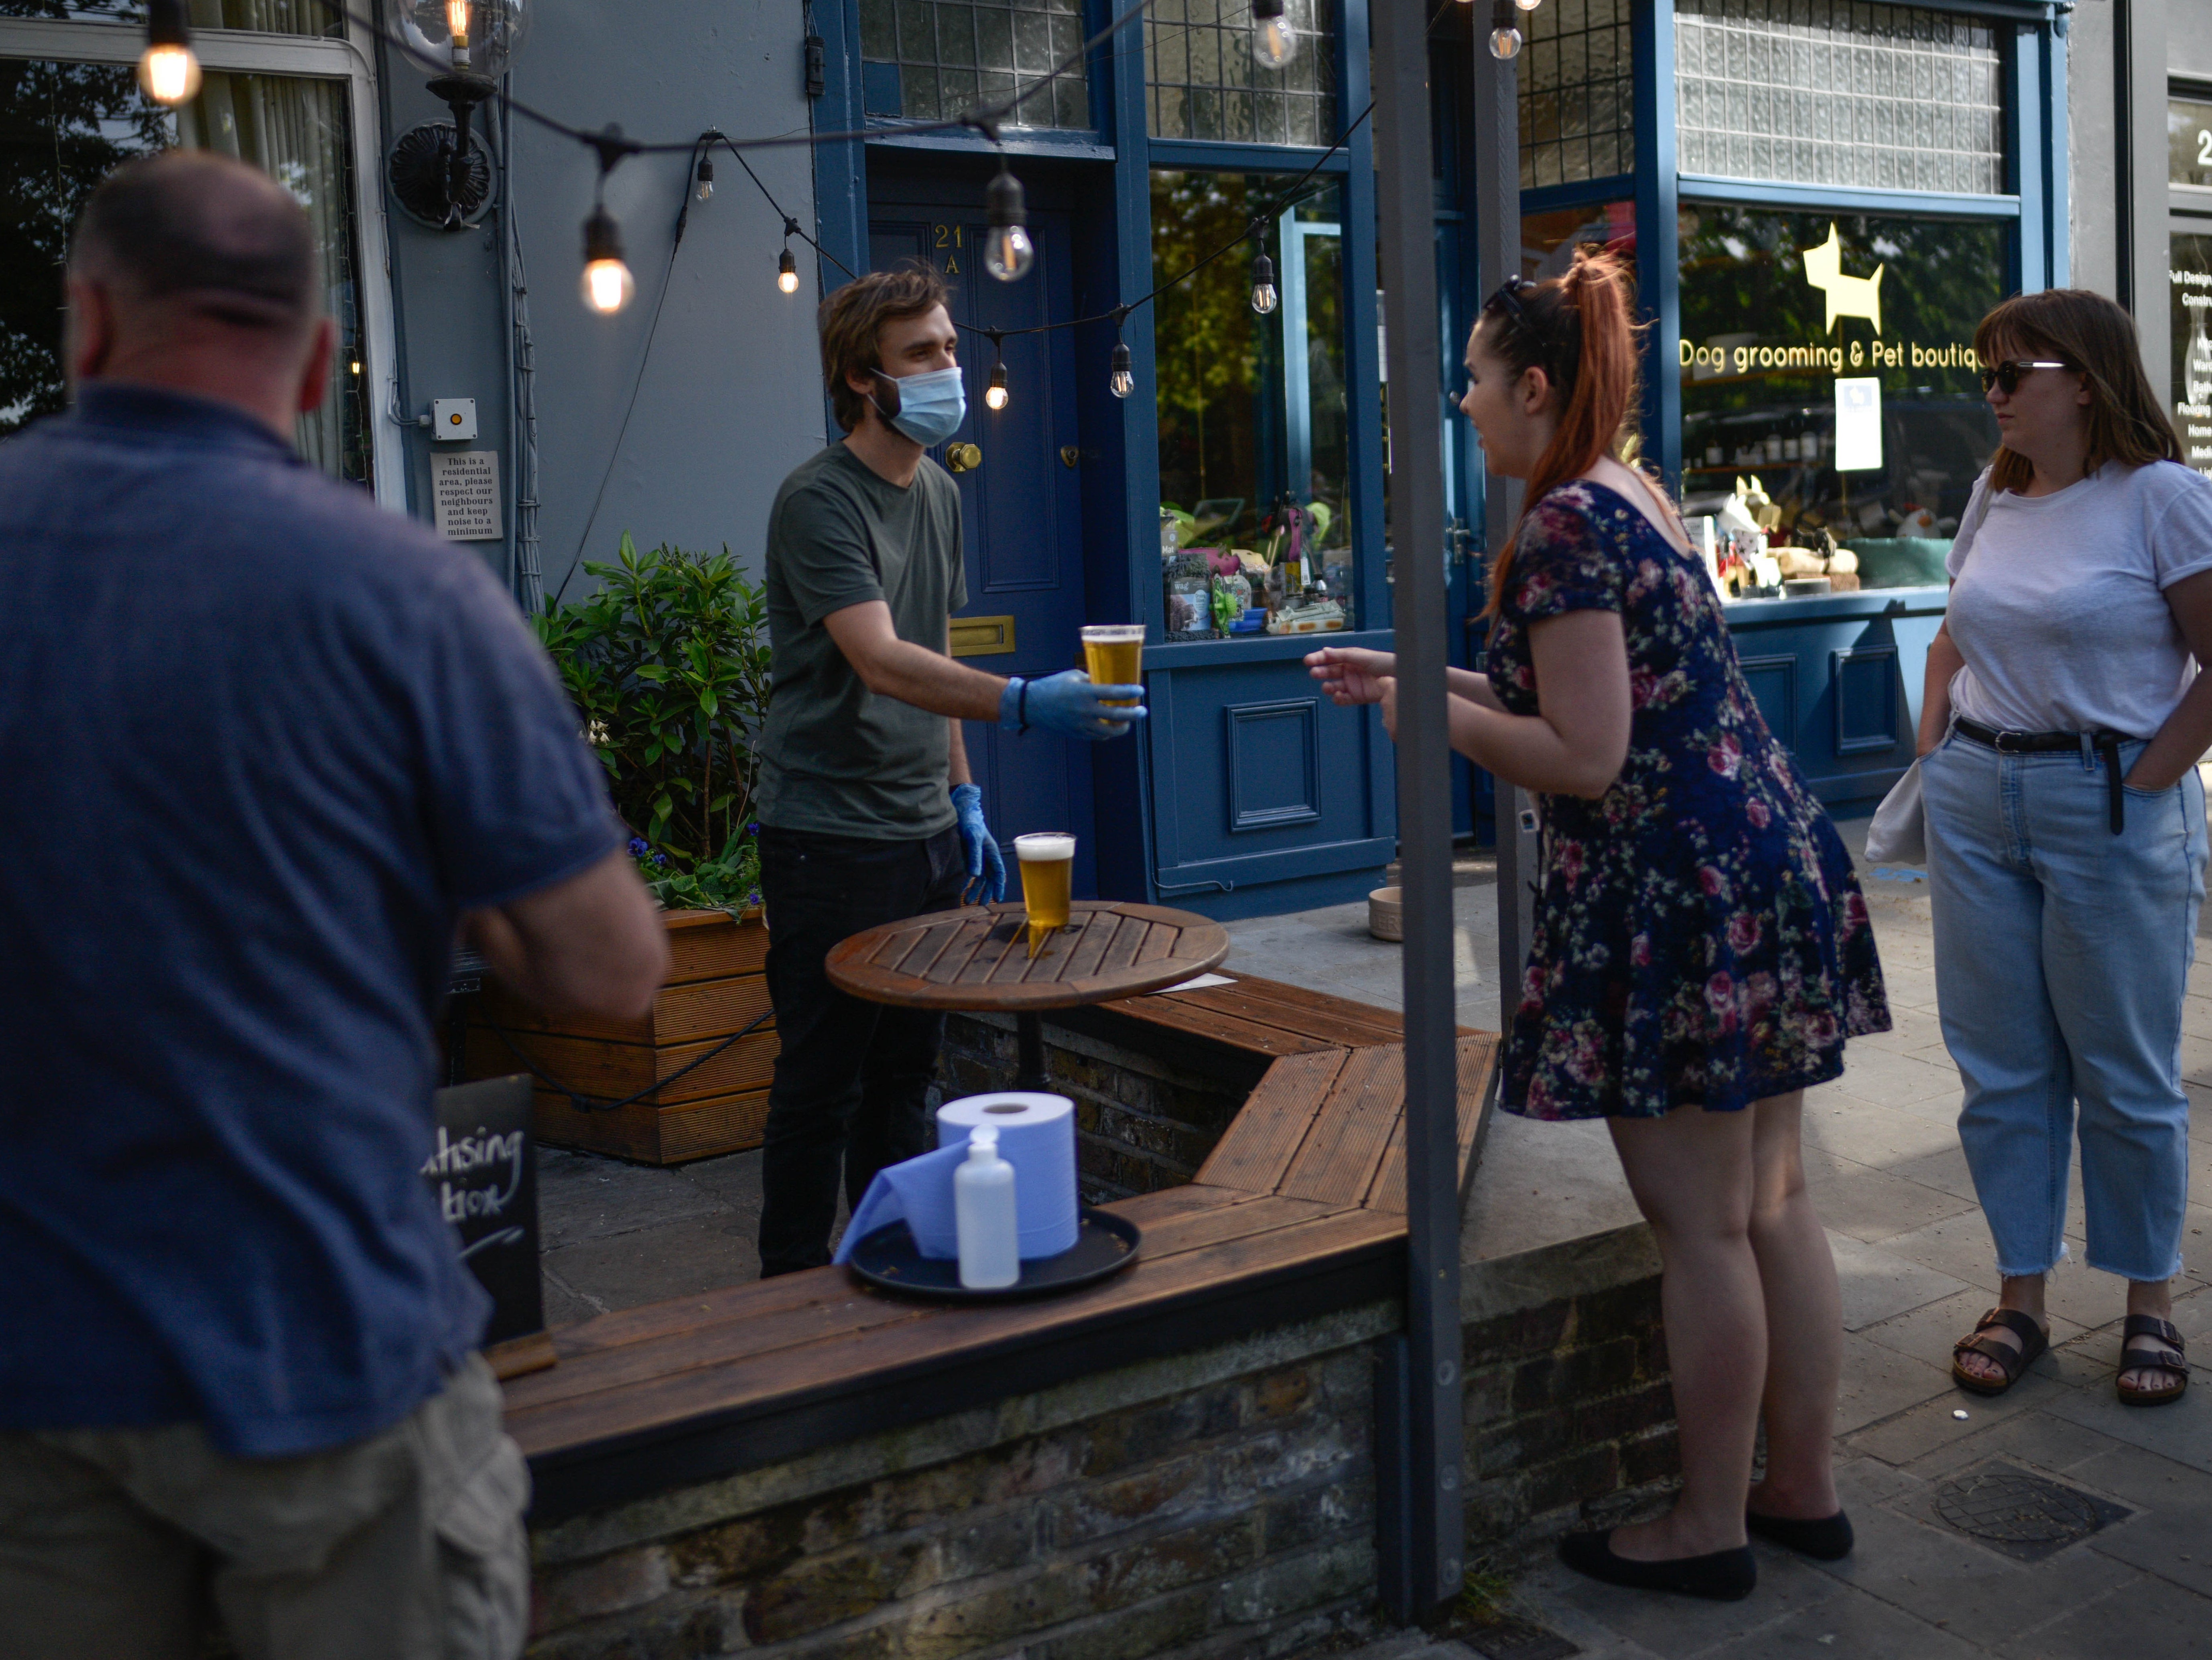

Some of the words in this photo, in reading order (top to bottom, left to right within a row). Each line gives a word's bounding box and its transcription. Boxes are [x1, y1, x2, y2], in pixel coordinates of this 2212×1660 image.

[2198, 129, 2212, 166] 2
[935, 224, 962, 248] 21
[945, 254, 960, 274] A
[1680, 339, 1725, 373] Dog
[1734, 342, 1842, 374] grooming
[1850, 341, 1865, 367] &
[1873, 341, 1903, 367] Pet
[2178, 402, 2210, 418] Flooring
[2188, 424, 2212, 437] Home
[2192, 445, 2212, 459] Medi
[443, 467, 491, 475] residential
[465, 477, 492, 486] please
[440, 488, 473, 497] respect
[441, 498, 493, 507] neighbours
[448, 508, 464, 516] and
[467, 507, 487, 516] keep
[448, 528, 493, 536] minimum
[1162, 546, 1174, 554] Mat
